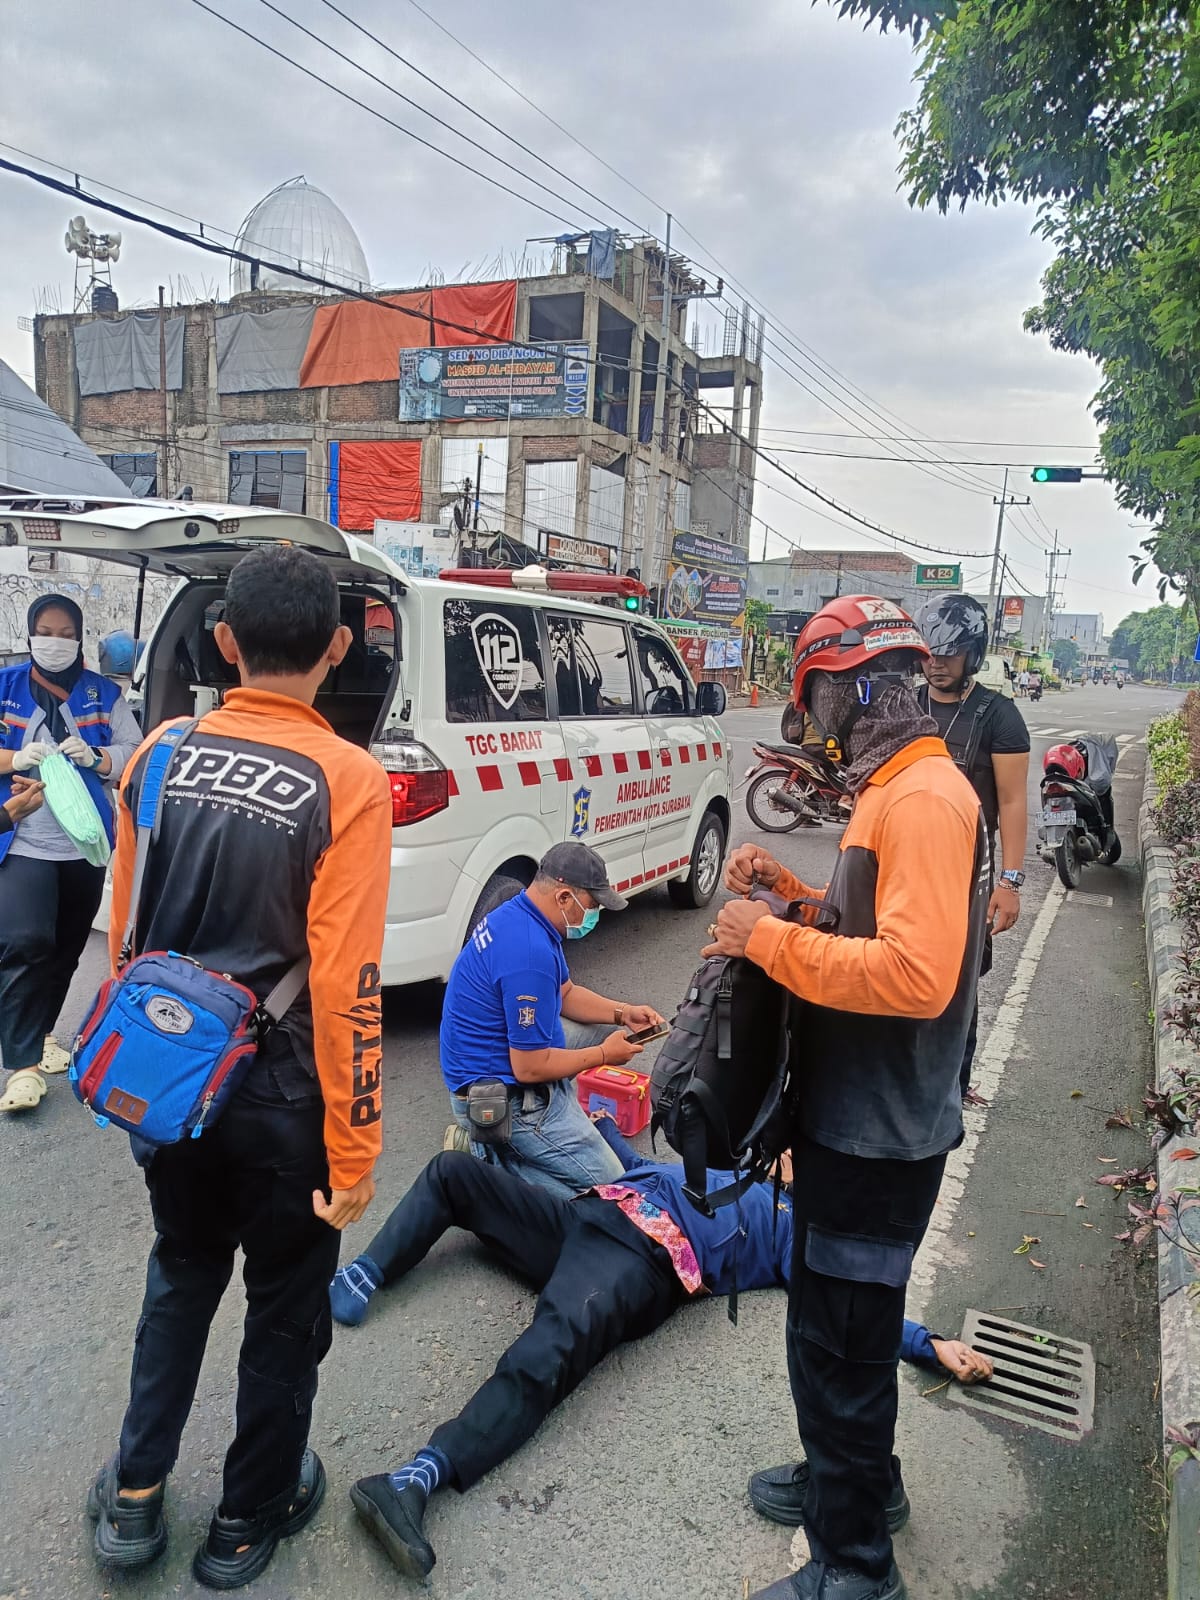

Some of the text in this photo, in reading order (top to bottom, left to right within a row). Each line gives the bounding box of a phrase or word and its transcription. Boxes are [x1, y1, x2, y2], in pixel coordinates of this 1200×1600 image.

[448, 349, 490, 361] SEDANG
[490, 346, 546, 360] DIBANGUN
[447, 362, 556, 376] MASJID AL-HIDAYAH
[667, 627, 699, 636] BANSER
[871, 621, 916, 631] DLIGHT
[480, 633, 521, 671] 112
[465, 730, 543, 756] TGC BARAT
[616, 774, 672, 804] AMBULANCE
[264, 810, 298, 828] DAERAH
[594, 794, 692, 834] PEMERINTAH KOTA SURABAYA
